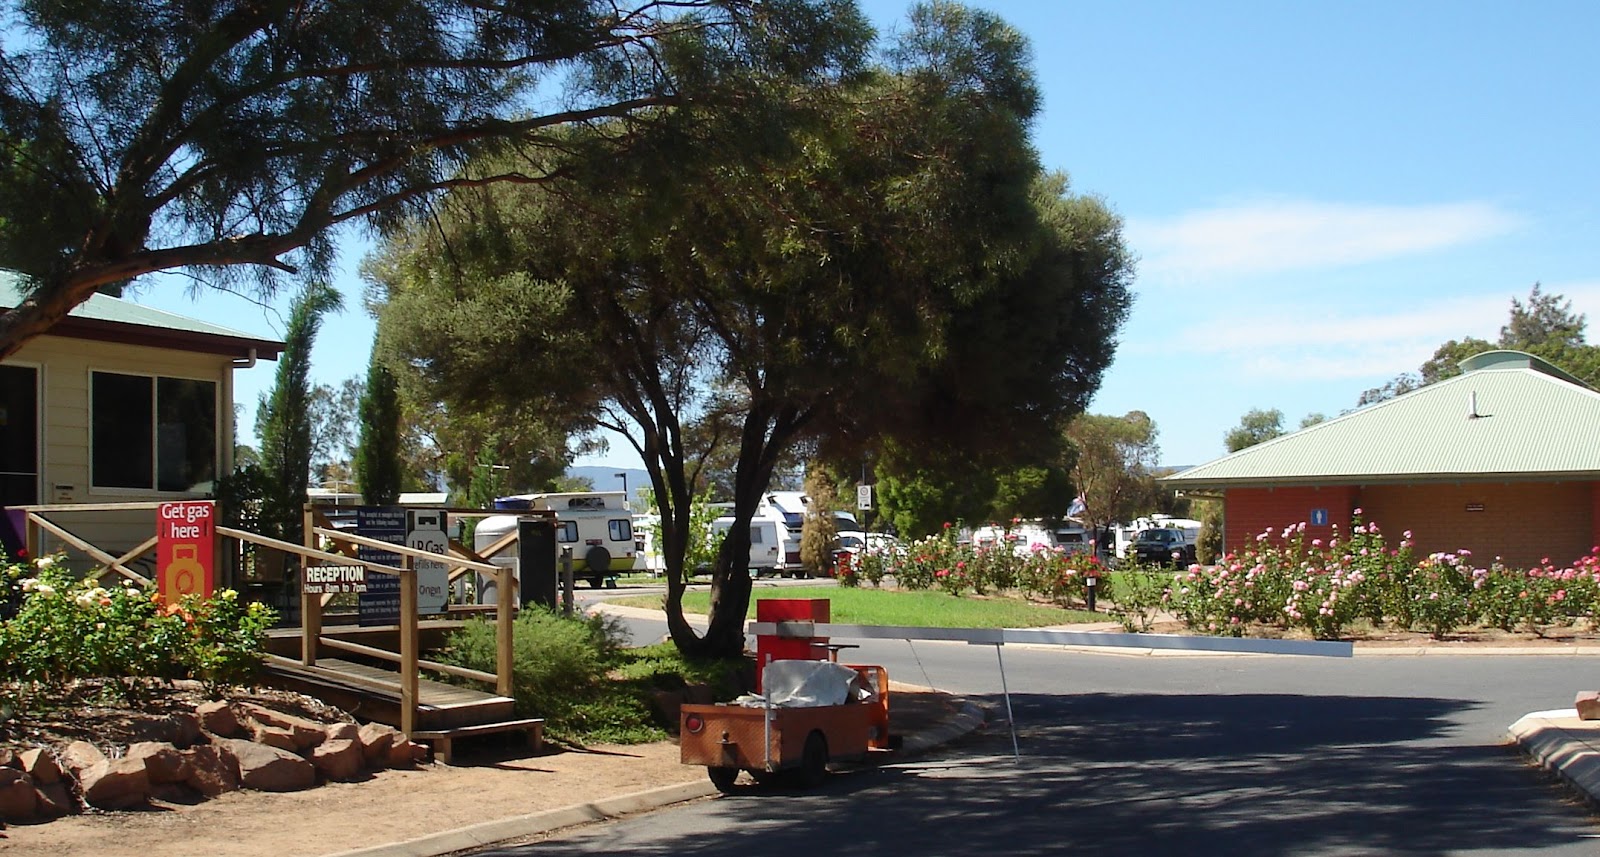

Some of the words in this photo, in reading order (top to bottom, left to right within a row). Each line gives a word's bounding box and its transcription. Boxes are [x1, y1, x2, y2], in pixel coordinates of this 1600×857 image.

[161, 503, 185, 519] Get
[187, 505, 209, 523] gas
[171, 522, 200, 539] here
[306, 566, 364, 582] RECEPTION
[304, 583, 323, 593] Hours
[325, 582, 340, 593] 8am
[342, 582, 350, 593] to
